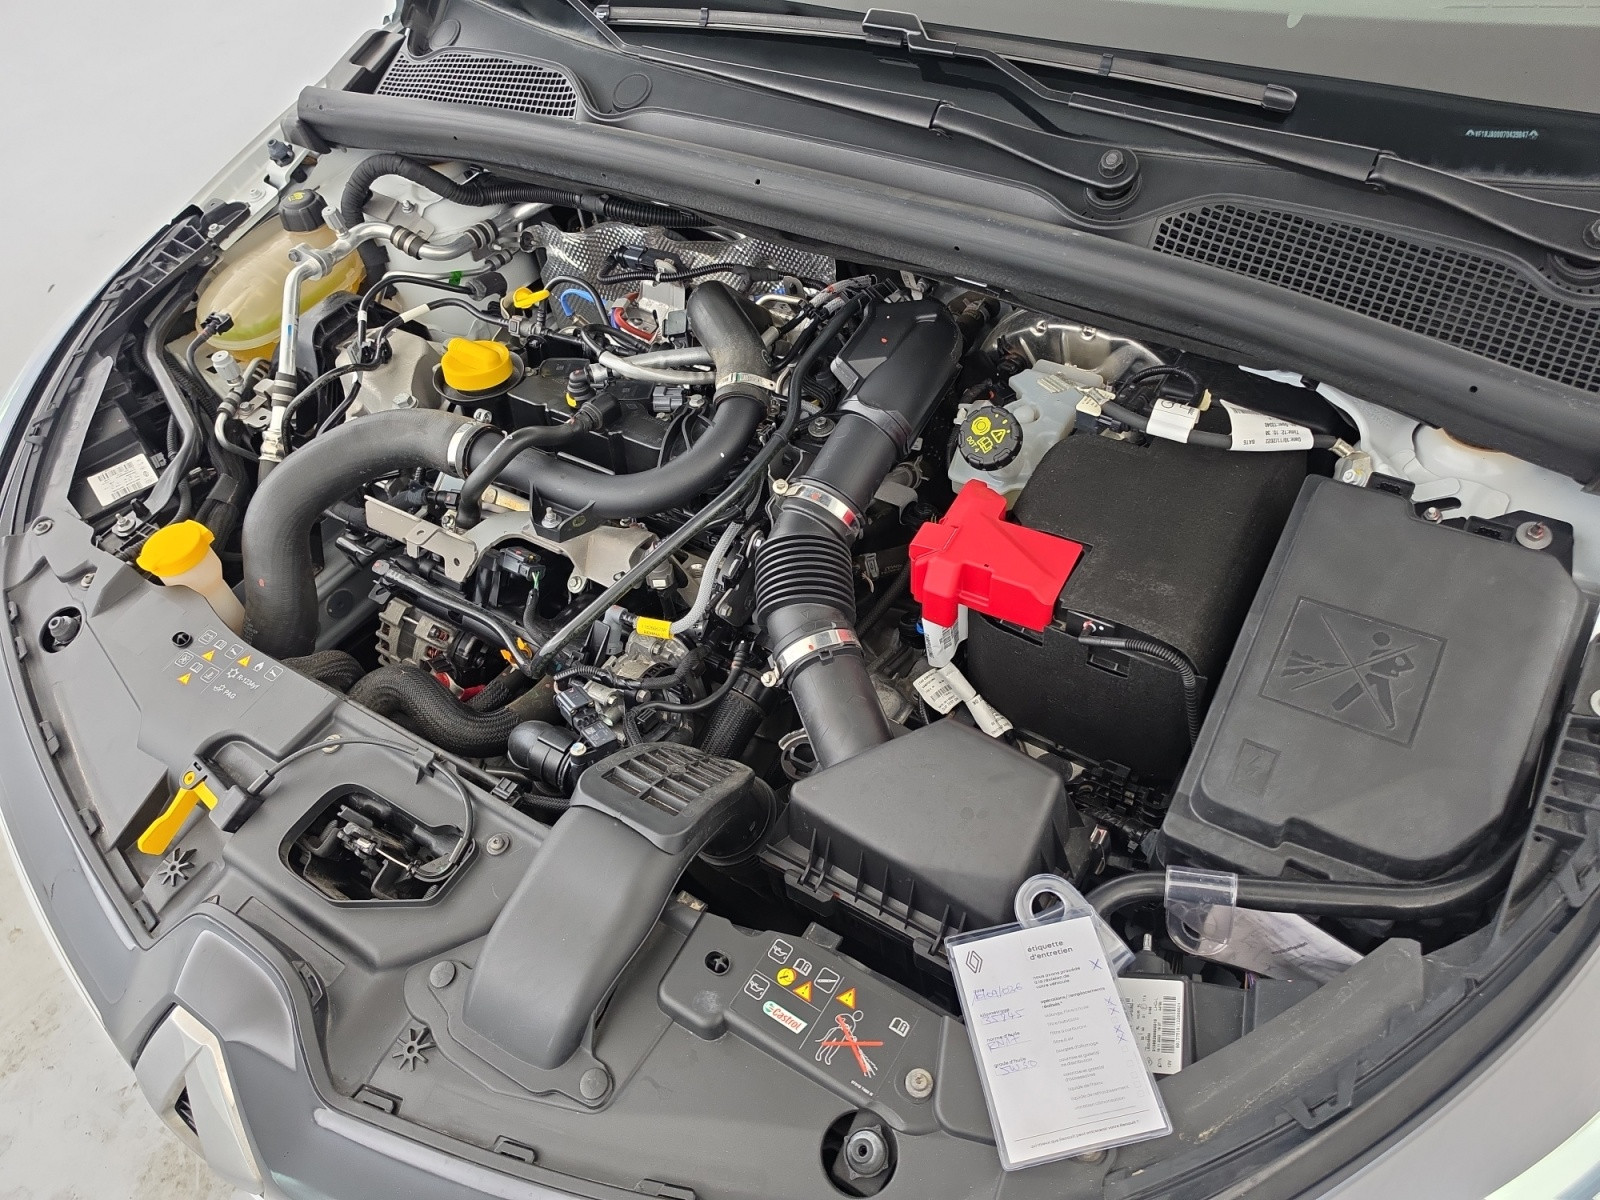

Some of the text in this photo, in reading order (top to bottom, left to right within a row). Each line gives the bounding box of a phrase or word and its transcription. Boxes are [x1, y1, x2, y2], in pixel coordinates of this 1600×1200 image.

[966, 436, 977, 447] DOT
[236, 674, 260, 690] R-1234yf
[223, 689, 236, 699] PAG
[1027, 941, 1064, 953] étiquette
[1029, 946, 1073, 960] d'entretien
[772, 1007, 802, 1031] Castrol
